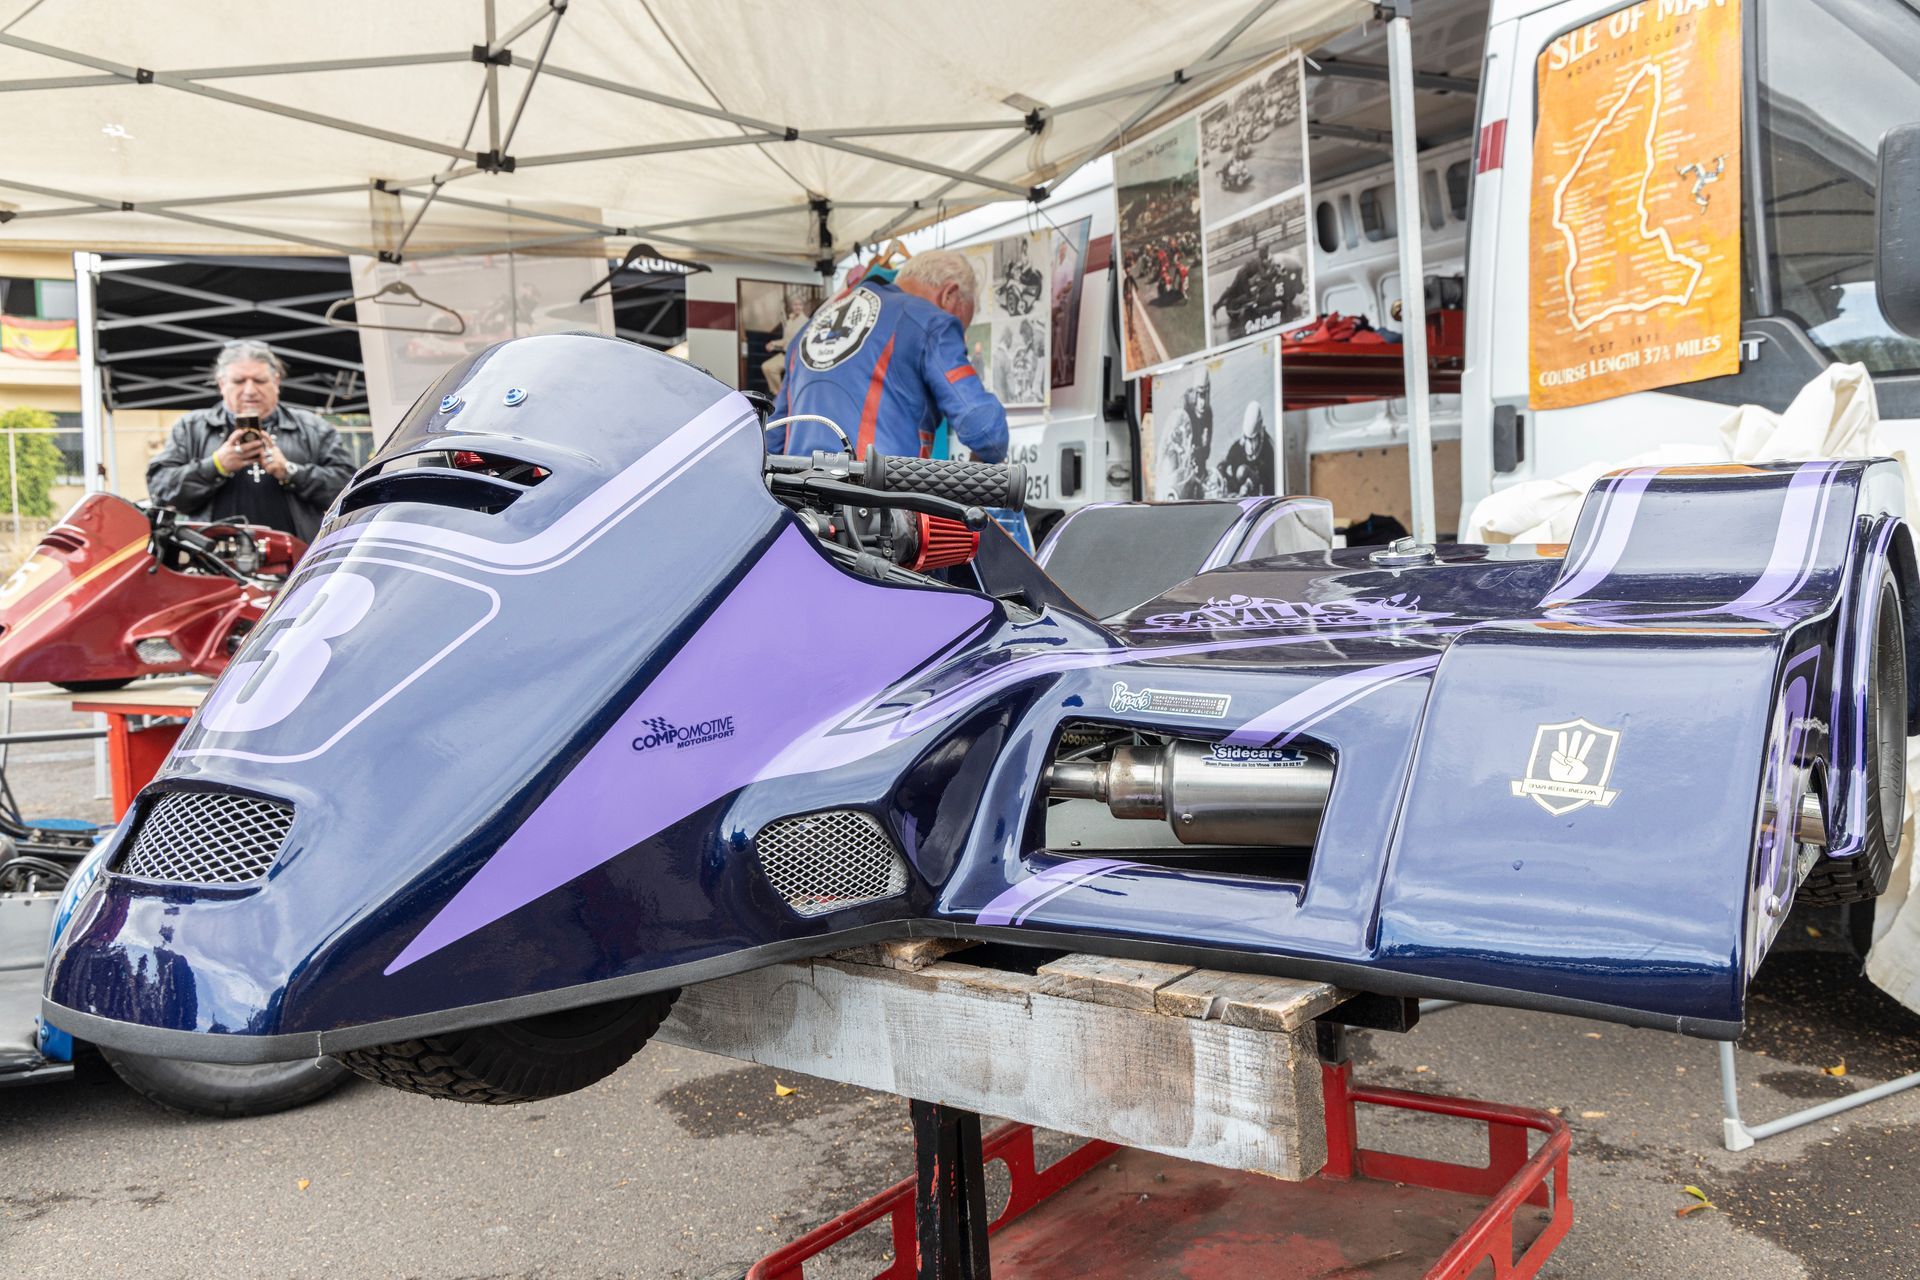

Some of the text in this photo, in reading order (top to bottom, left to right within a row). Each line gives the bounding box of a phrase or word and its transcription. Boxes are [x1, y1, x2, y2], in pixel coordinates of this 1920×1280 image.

[1549, 20, 1603, 71] SLE
[1539, 360, 1588, 388] COURSE
[1589, 351, 1640, 378] LENGTH
[1675, 335, 1721, 360] MILES
[201, 572, 375, 732] 3
[632, 716, 735, 751] COMPOMOTIVE
[677, 730, 735, 749] MOTORSPORT
[1217, 747, 1283, 759] Sidecars
